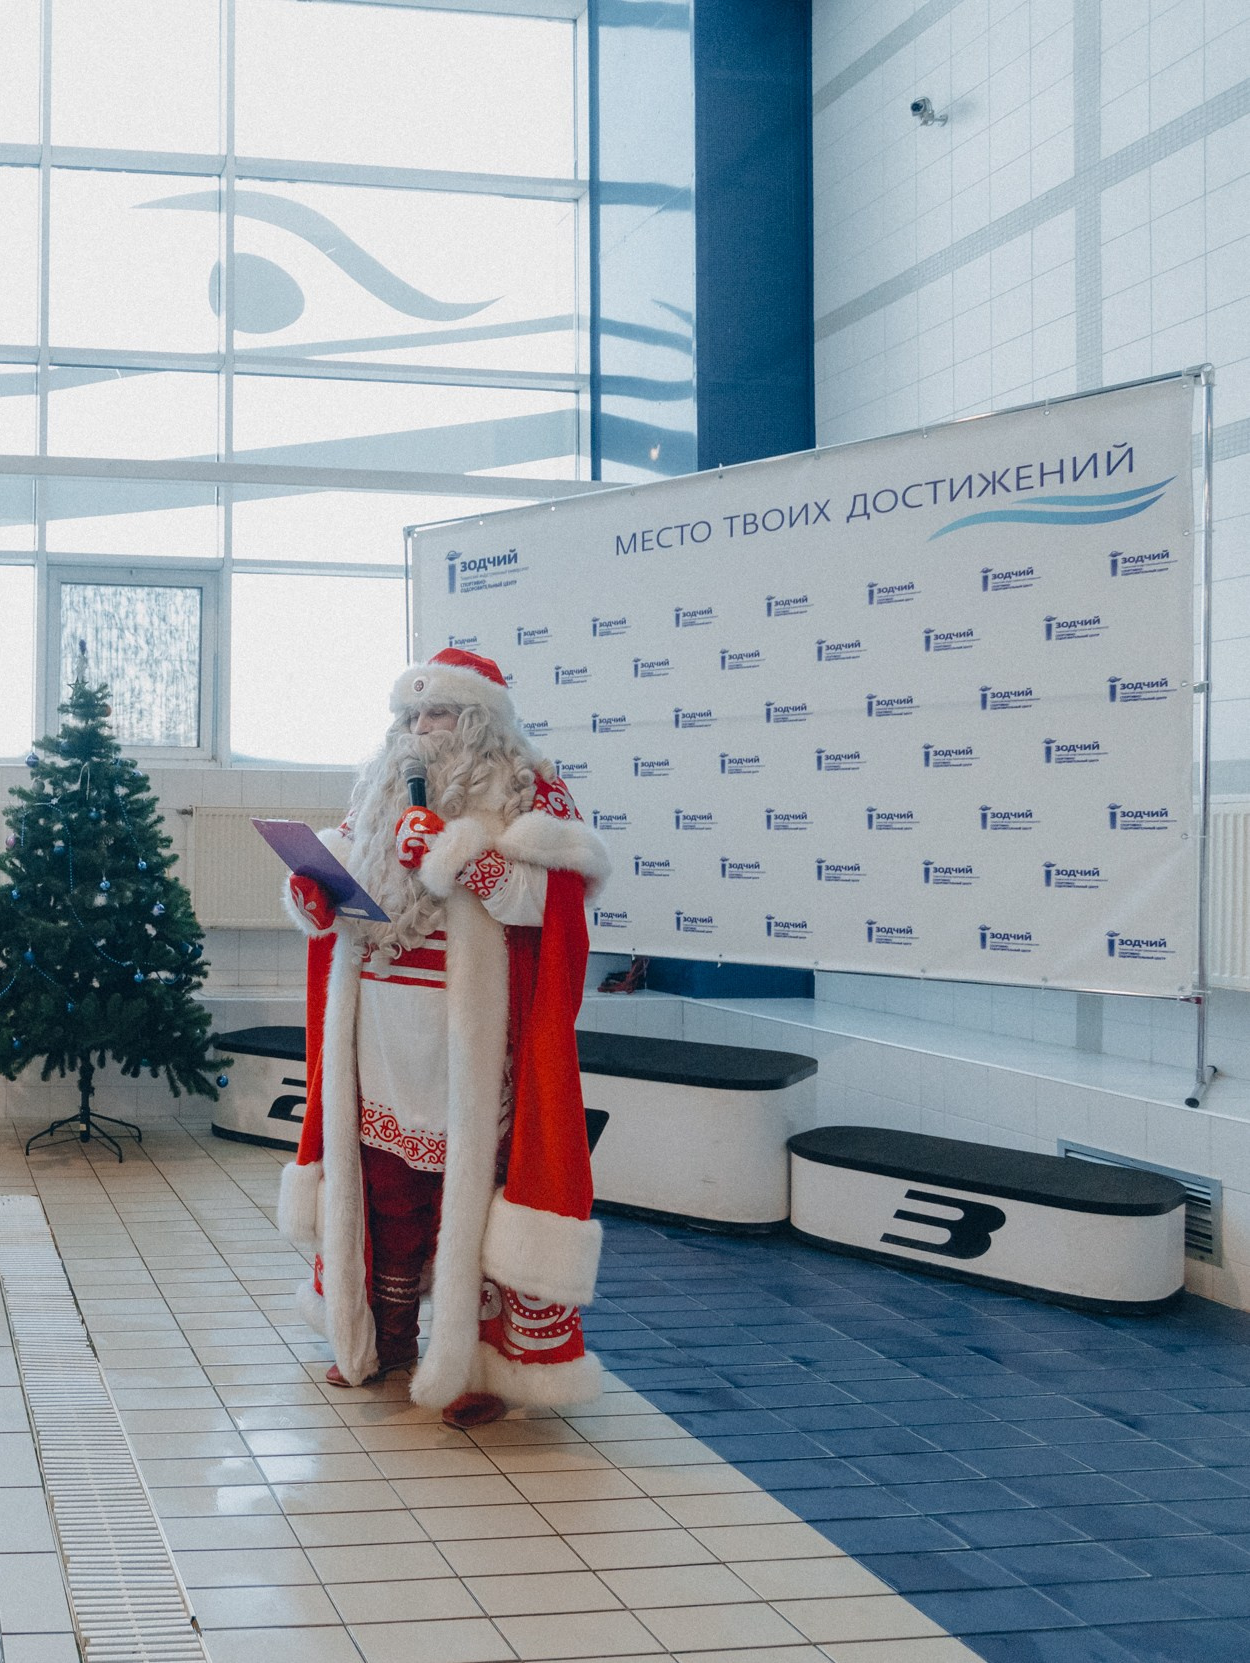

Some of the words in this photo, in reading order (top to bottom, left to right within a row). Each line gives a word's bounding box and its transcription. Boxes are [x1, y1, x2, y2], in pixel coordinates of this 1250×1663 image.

[616, 521, 712, 556] МЕСТО
[723, 499, 831, 538] ТВОИХ
[846, 442, 1134, 524] ДОСТИЖЕНИЙ
[880, 1189, 1006, 1259] 3
